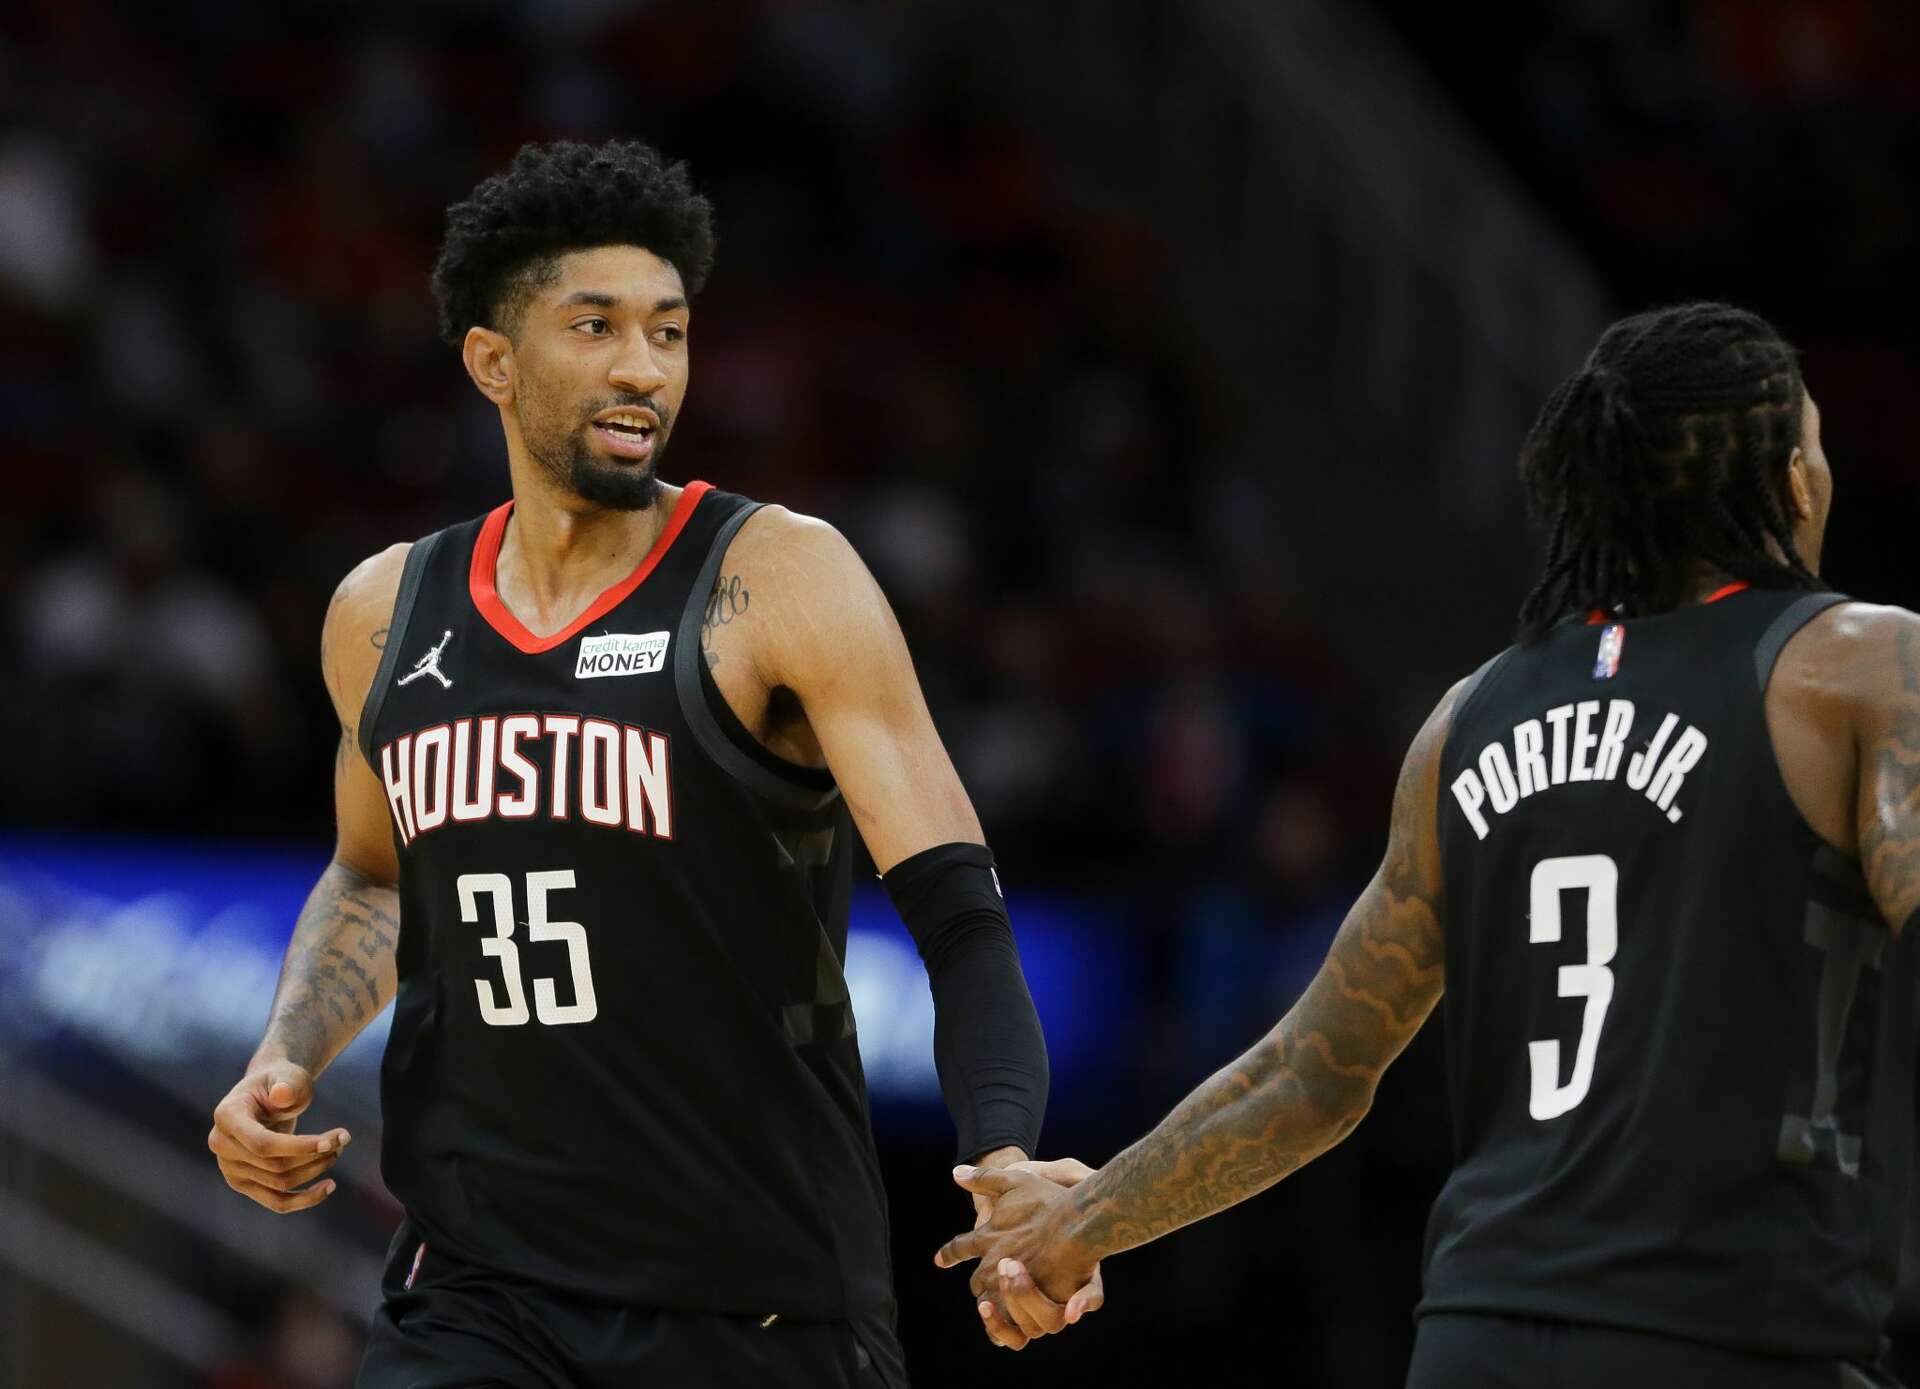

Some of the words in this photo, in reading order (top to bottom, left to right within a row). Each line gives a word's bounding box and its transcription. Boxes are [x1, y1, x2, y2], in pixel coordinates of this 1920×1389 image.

[579, 650, 661, 674] MONEY
[583, 638, 620, 654] credit
[623, 639, 666, 652] karma
[382, 713, 673, 847] HOUSTON
[1451, 699, 1635, 840] PORTER
[1626, 712, 1708, 823] JR.
[457, 869, 597, 1025] 35
[1528, 854, 1619, 1121] 3
